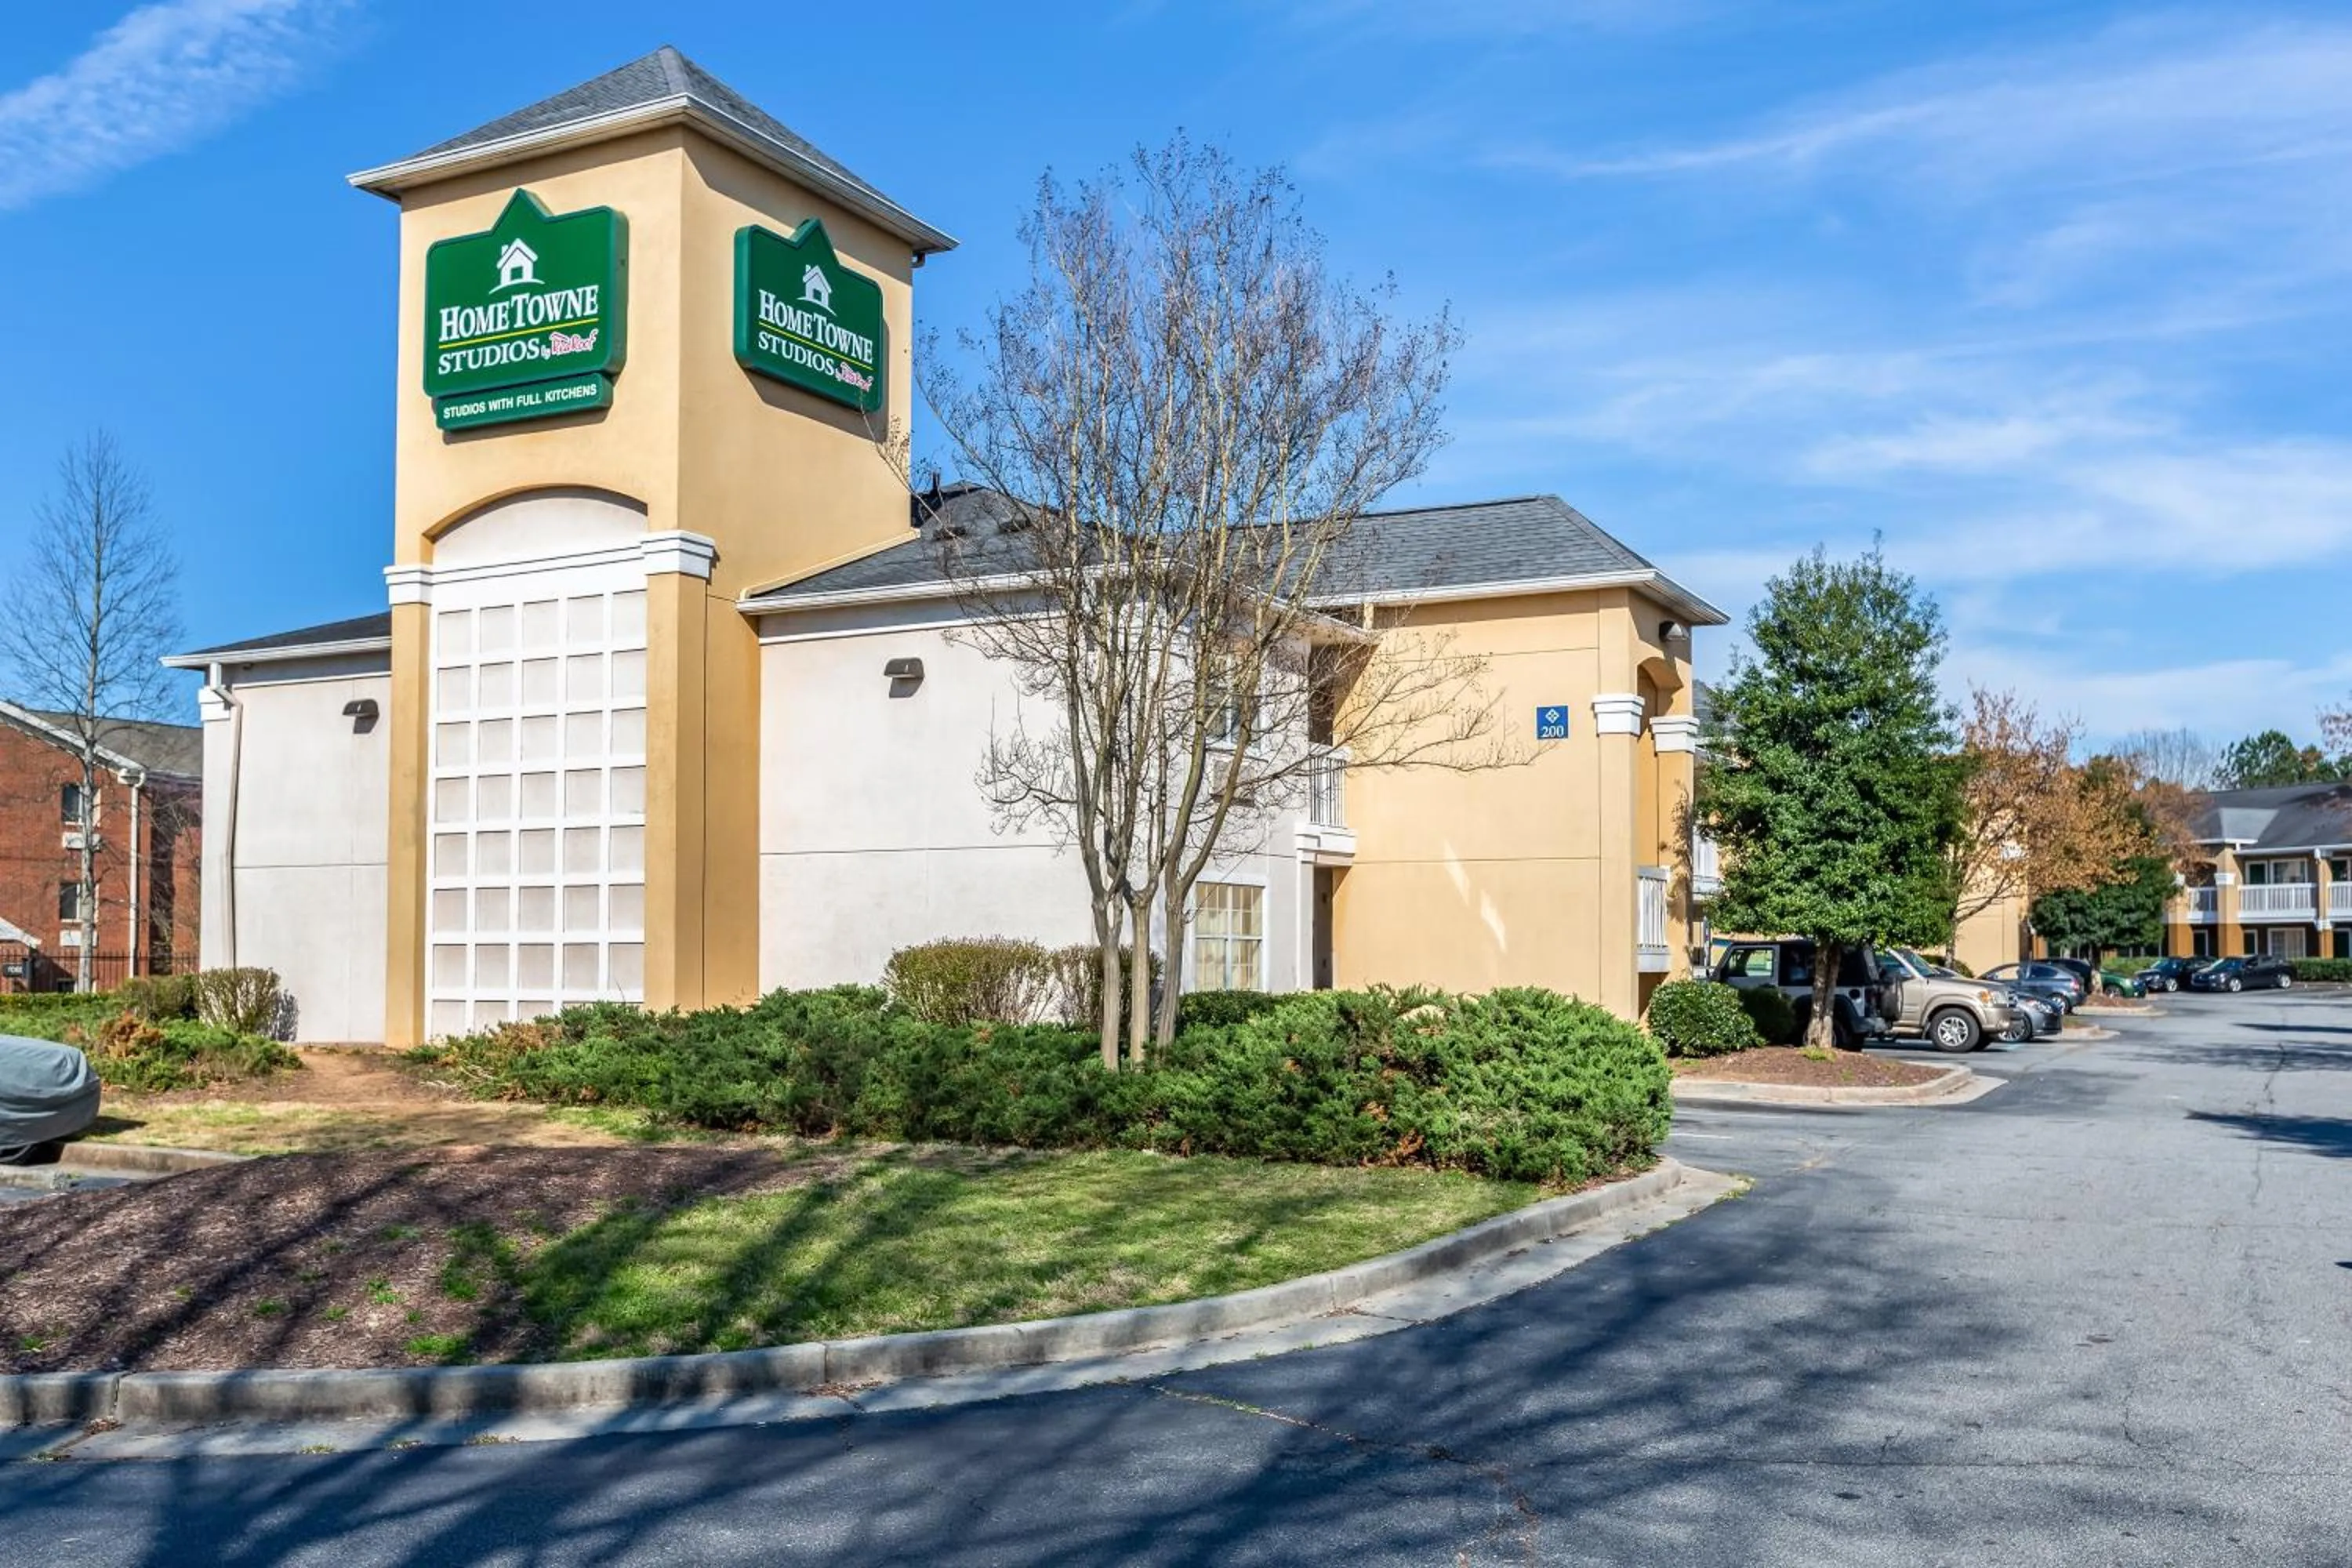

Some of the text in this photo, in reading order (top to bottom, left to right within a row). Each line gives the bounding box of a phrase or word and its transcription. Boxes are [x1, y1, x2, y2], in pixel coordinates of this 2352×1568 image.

[438, 338, 540, 376] STUDIOS
[757, 331, 835, 376] STUDIOS
[443, 383, 597, 419] STUDIOS WITH FULL KITCHENS
[1541, 725, 1565, 738] 200
